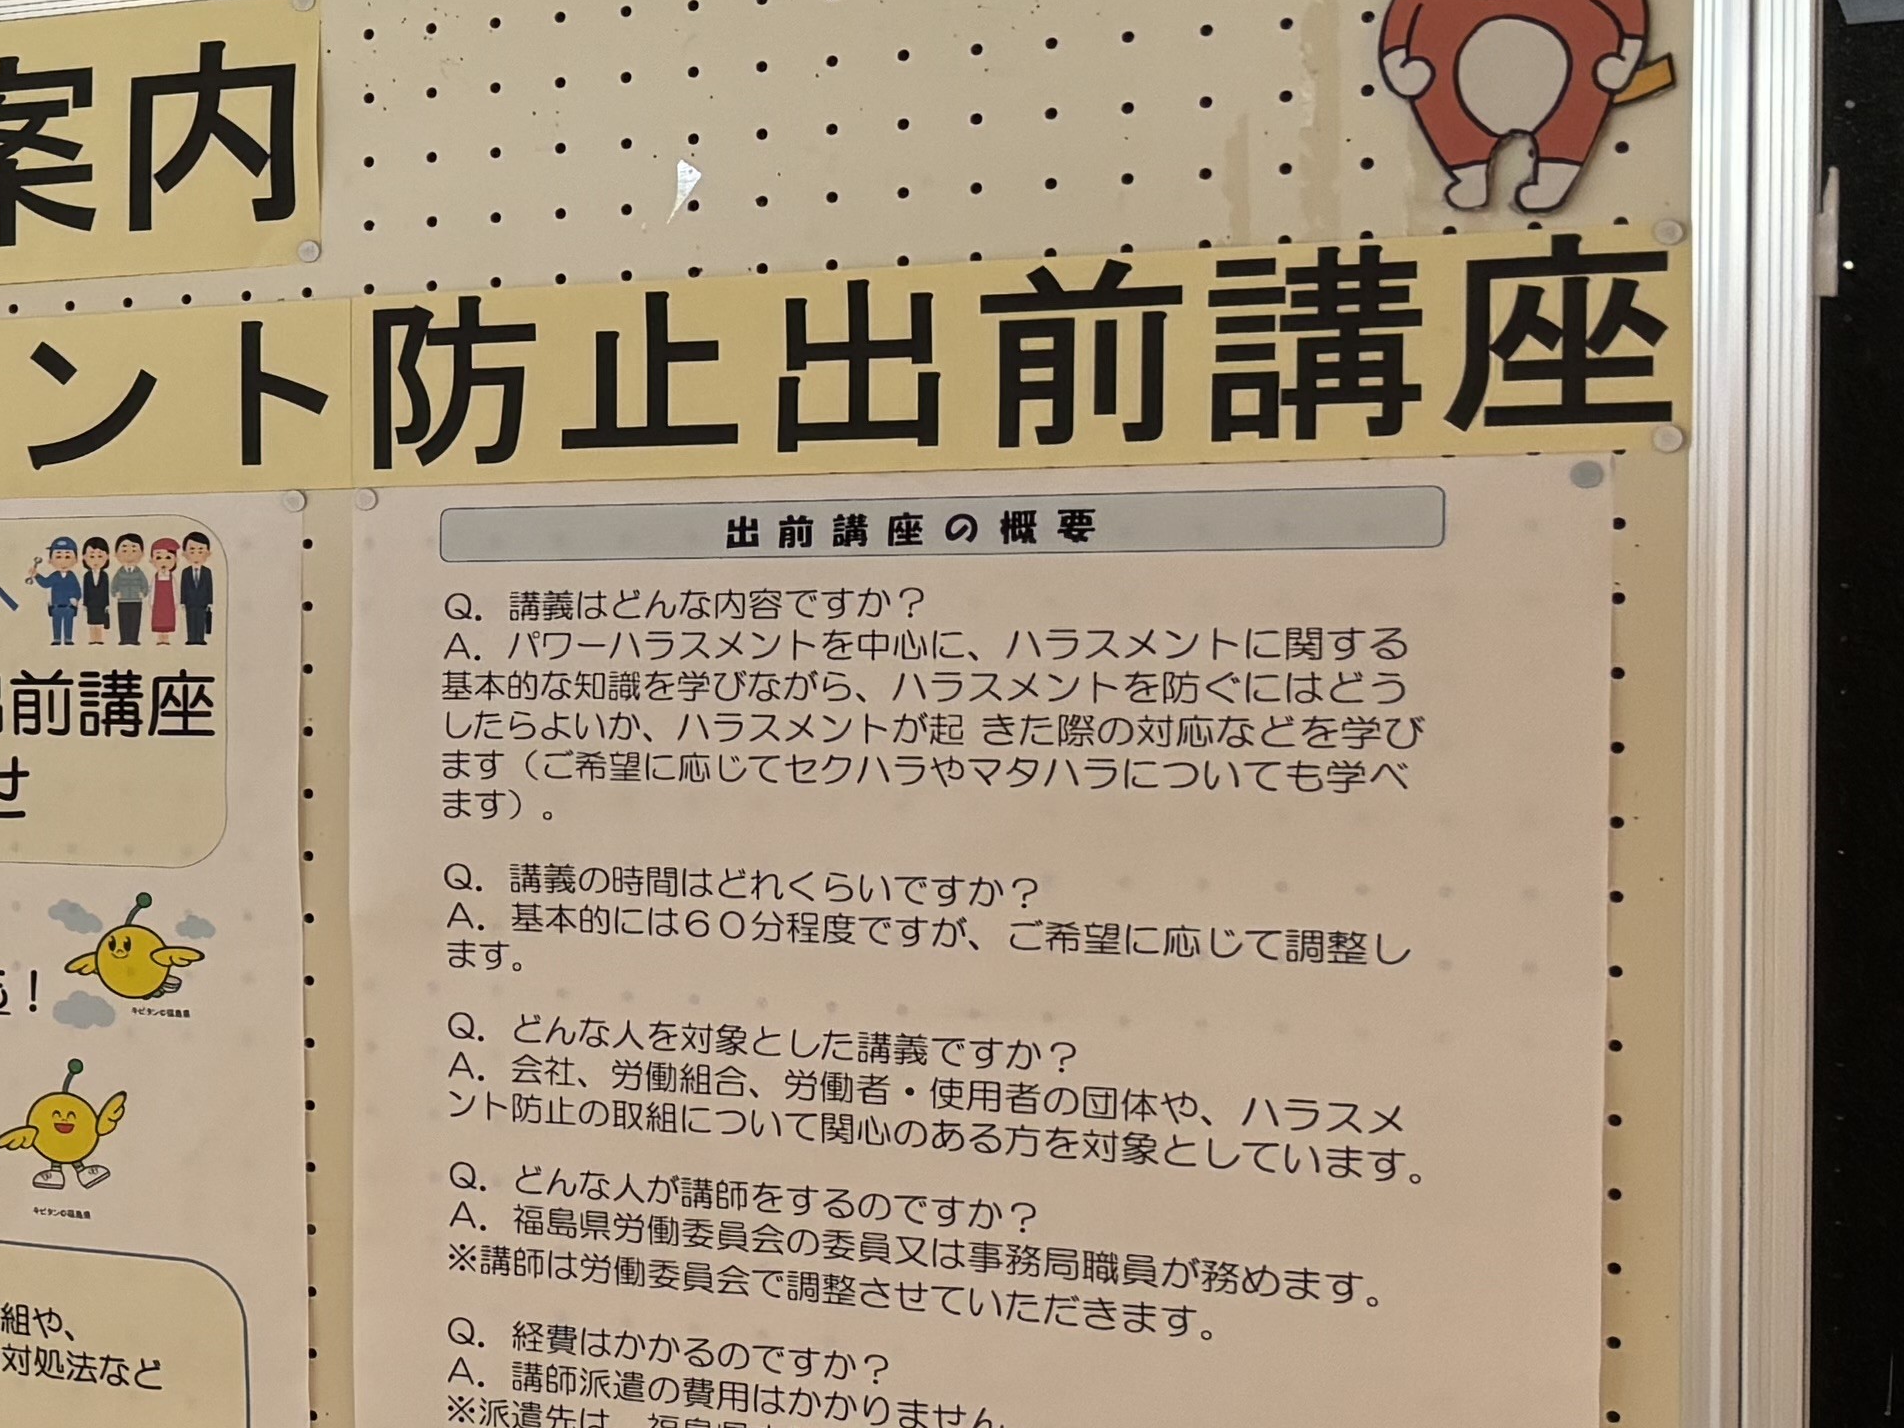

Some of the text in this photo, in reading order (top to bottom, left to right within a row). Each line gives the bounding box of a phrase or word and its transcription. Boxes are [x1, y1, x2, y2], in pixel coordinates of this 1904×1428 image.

[724, 507, 1099, 550] 出前講座の概要
[442, 667, 1407, 706] 基本的な知識を学びながら、ハラスメントを防ぐにはどう
[442, 750, 1408, 794] ます（ご希望に応じてセクハラやマタハラについても学べ
[442, 788, 556, 823] ます）。
[446, 939, 526, 974] ます。
[448, 1090, 1424, 1185] ント防止の取組について関心のある方を対象としています。
[447, 1244, 1214, 1342] ※講師は労働委員会で調整させていただきます。
